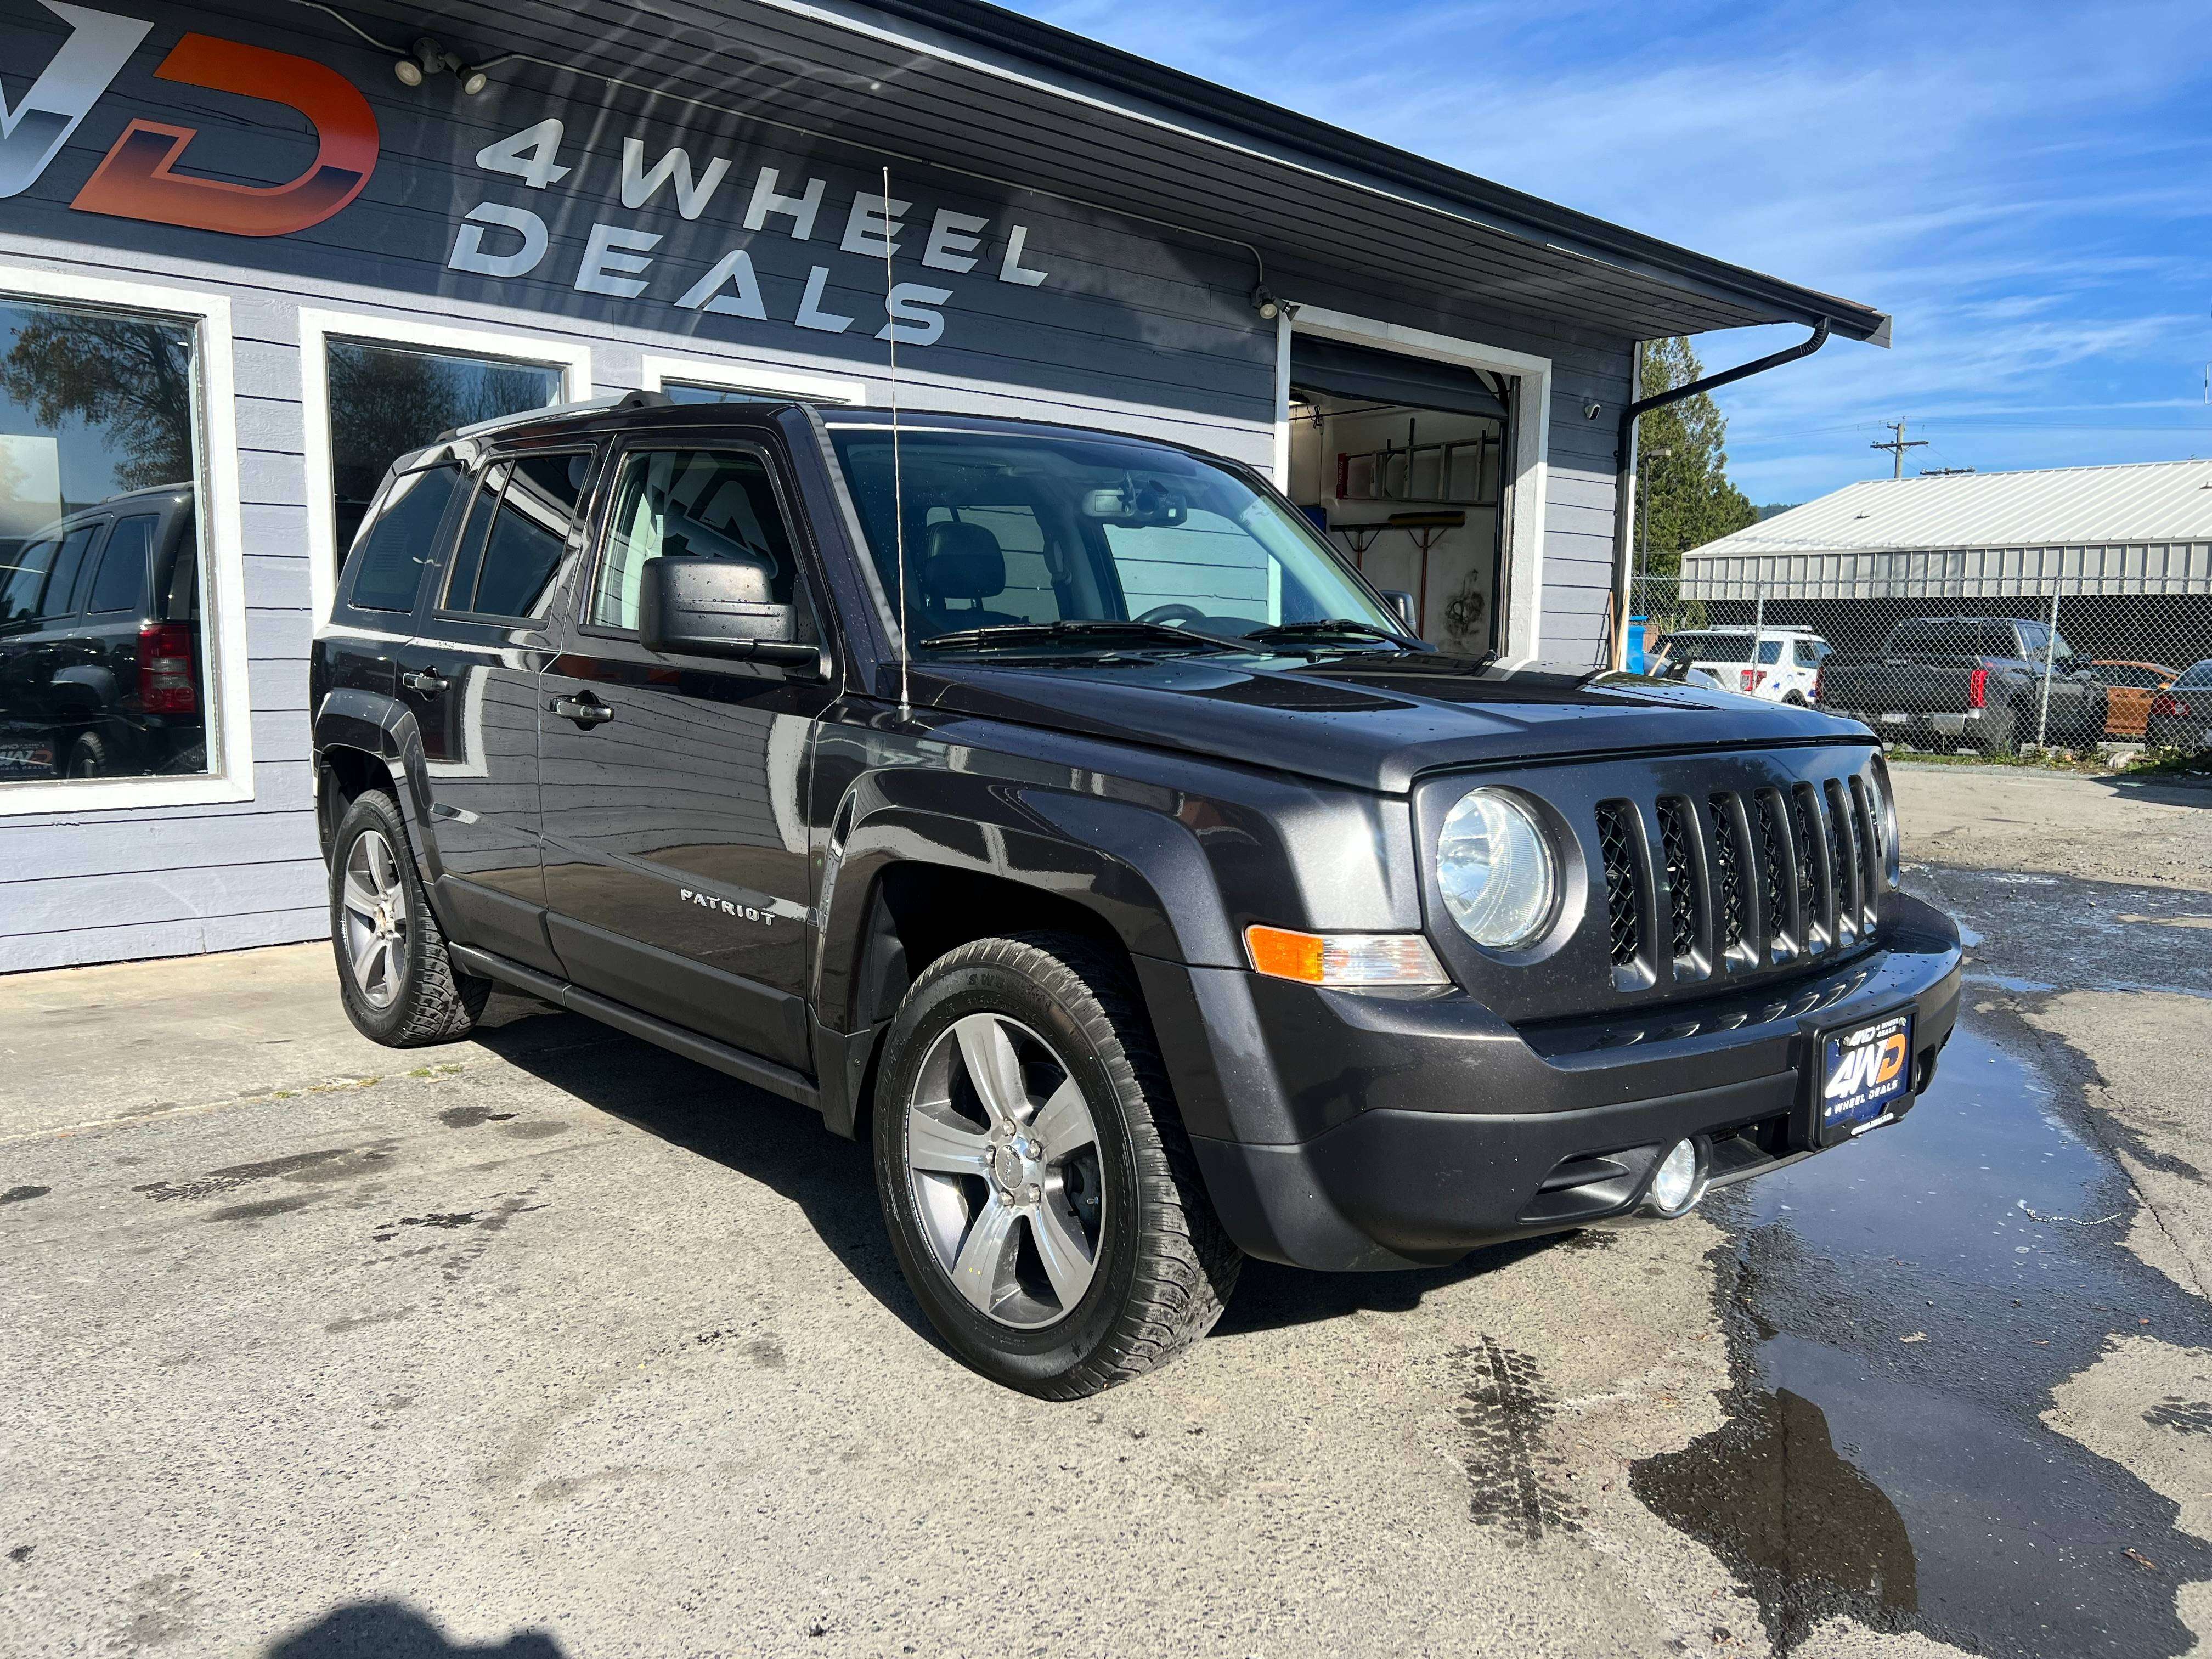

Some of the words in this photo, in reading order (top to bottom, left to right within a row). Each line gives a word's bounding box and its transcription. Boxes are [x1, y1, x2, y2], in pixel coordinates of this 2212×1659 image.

[476, 119, 571, 189] 4
[622, 137, 1048, 287] WHEEL
[447, 201, 953, 346] DEALS
[680, 889, 776, 926] PATRIOT
[1824, 1107, 1832, 1117] 4
[1835, 1093, 1865, 1114] WHEEL
[1868, 1079, 1899, 1100] DEALS
